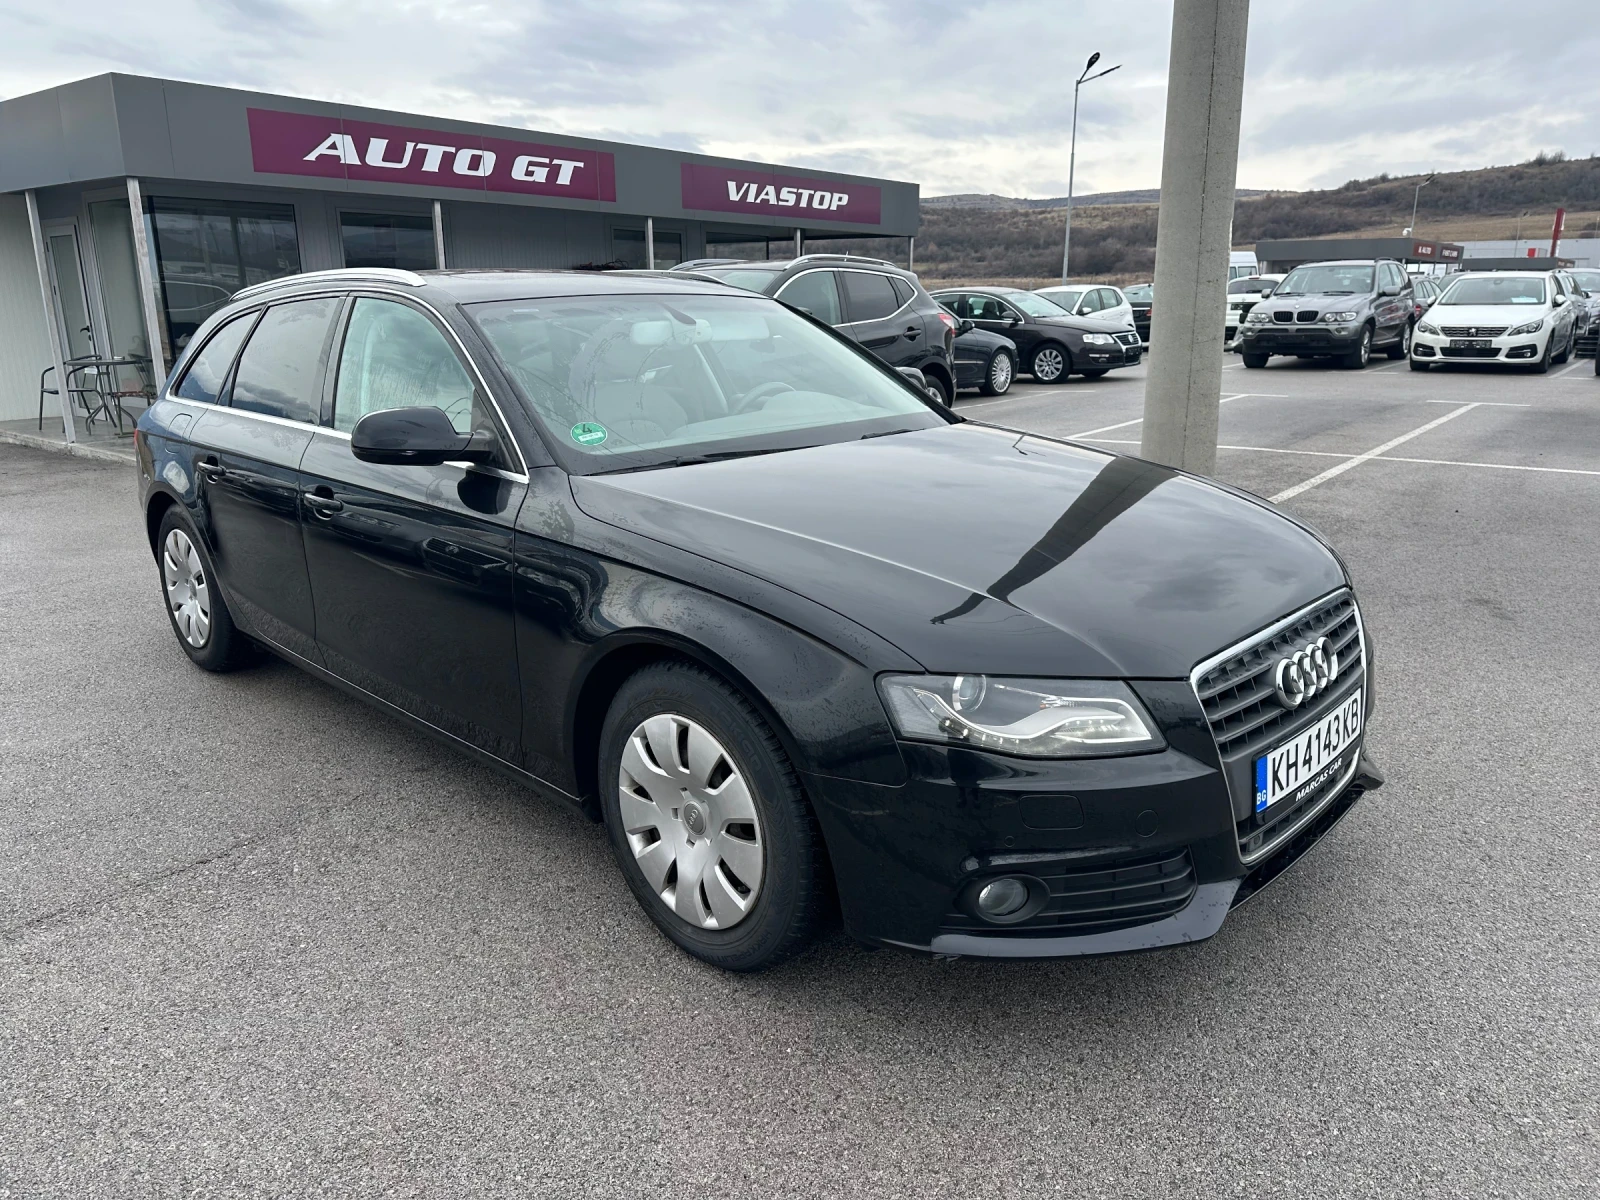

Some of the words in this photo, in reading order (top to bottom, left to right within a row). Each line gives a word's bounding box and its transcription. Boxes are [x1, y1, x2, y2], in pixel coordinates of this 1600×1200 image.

[303, 133, 497, 177] AUTO
[510, 155, 584, 185] GT
[727, 181, 849, 211] VIASTOP
[1256, 789, 1267, 806] BG
[1295, 770, 1328, 802] MARCAS
[1329, 757, 1342, 775] CAR
